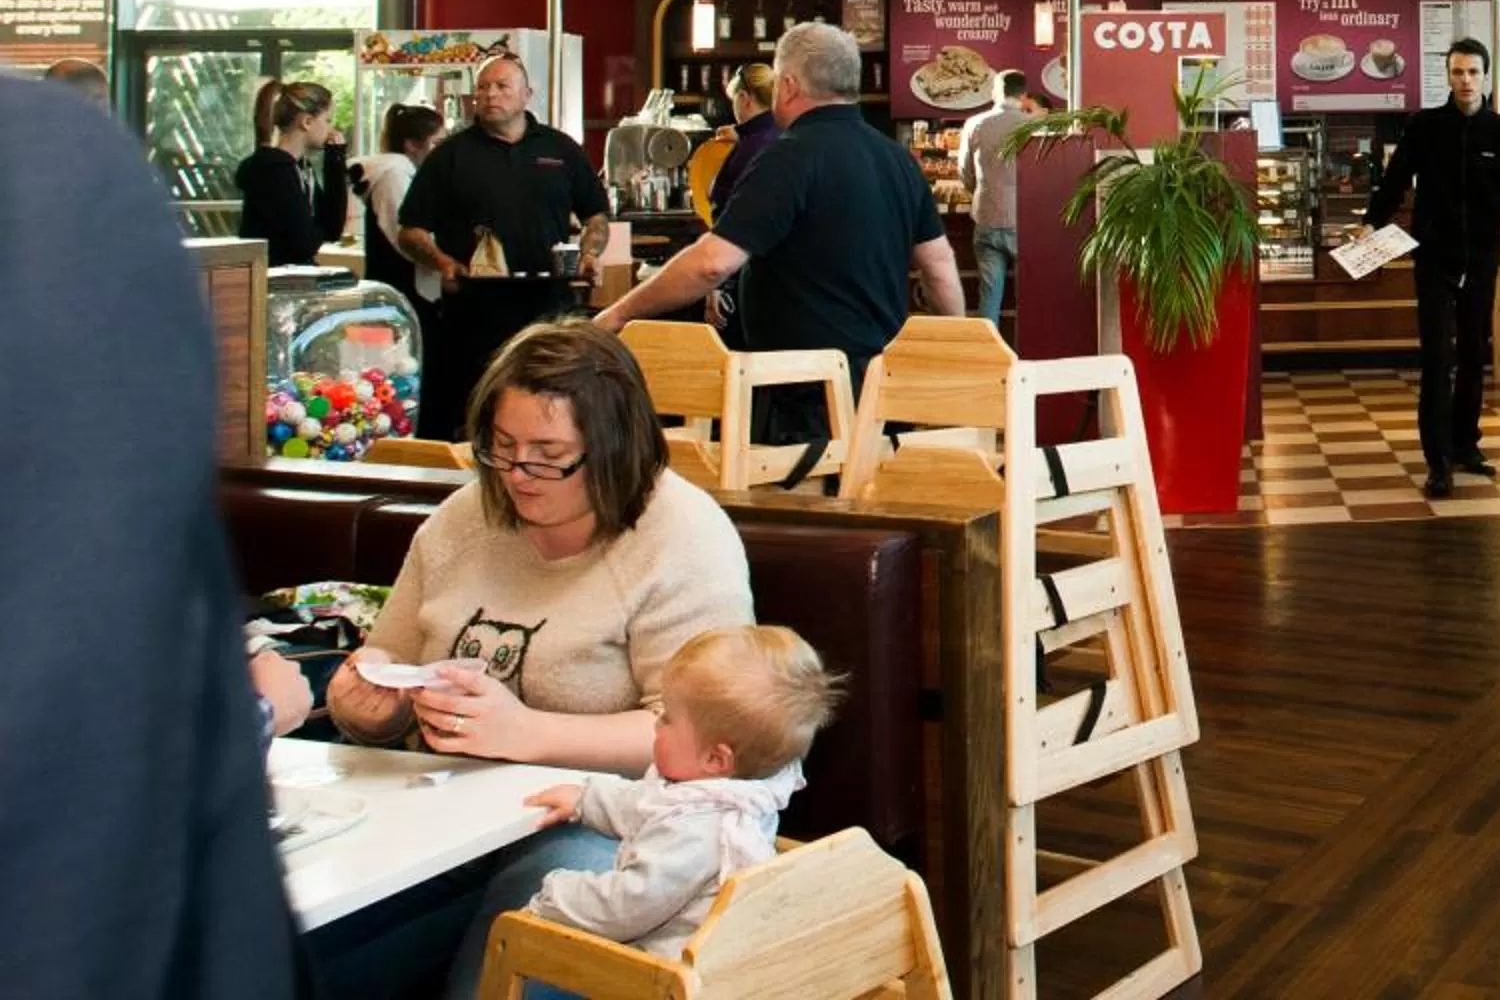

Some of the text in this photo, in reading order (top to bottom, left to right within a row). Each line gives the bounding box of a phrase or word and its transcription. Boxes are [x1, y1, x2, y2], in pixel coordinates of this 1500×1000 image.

[947, 0, 982, 12] warm
[935, 13, 1011, 31] wonderfully
[1341, 11, 1400, 28] ordinary
[957, 29, 999, 43] creamy
[1093, 21, 1213, 53] COSTA
